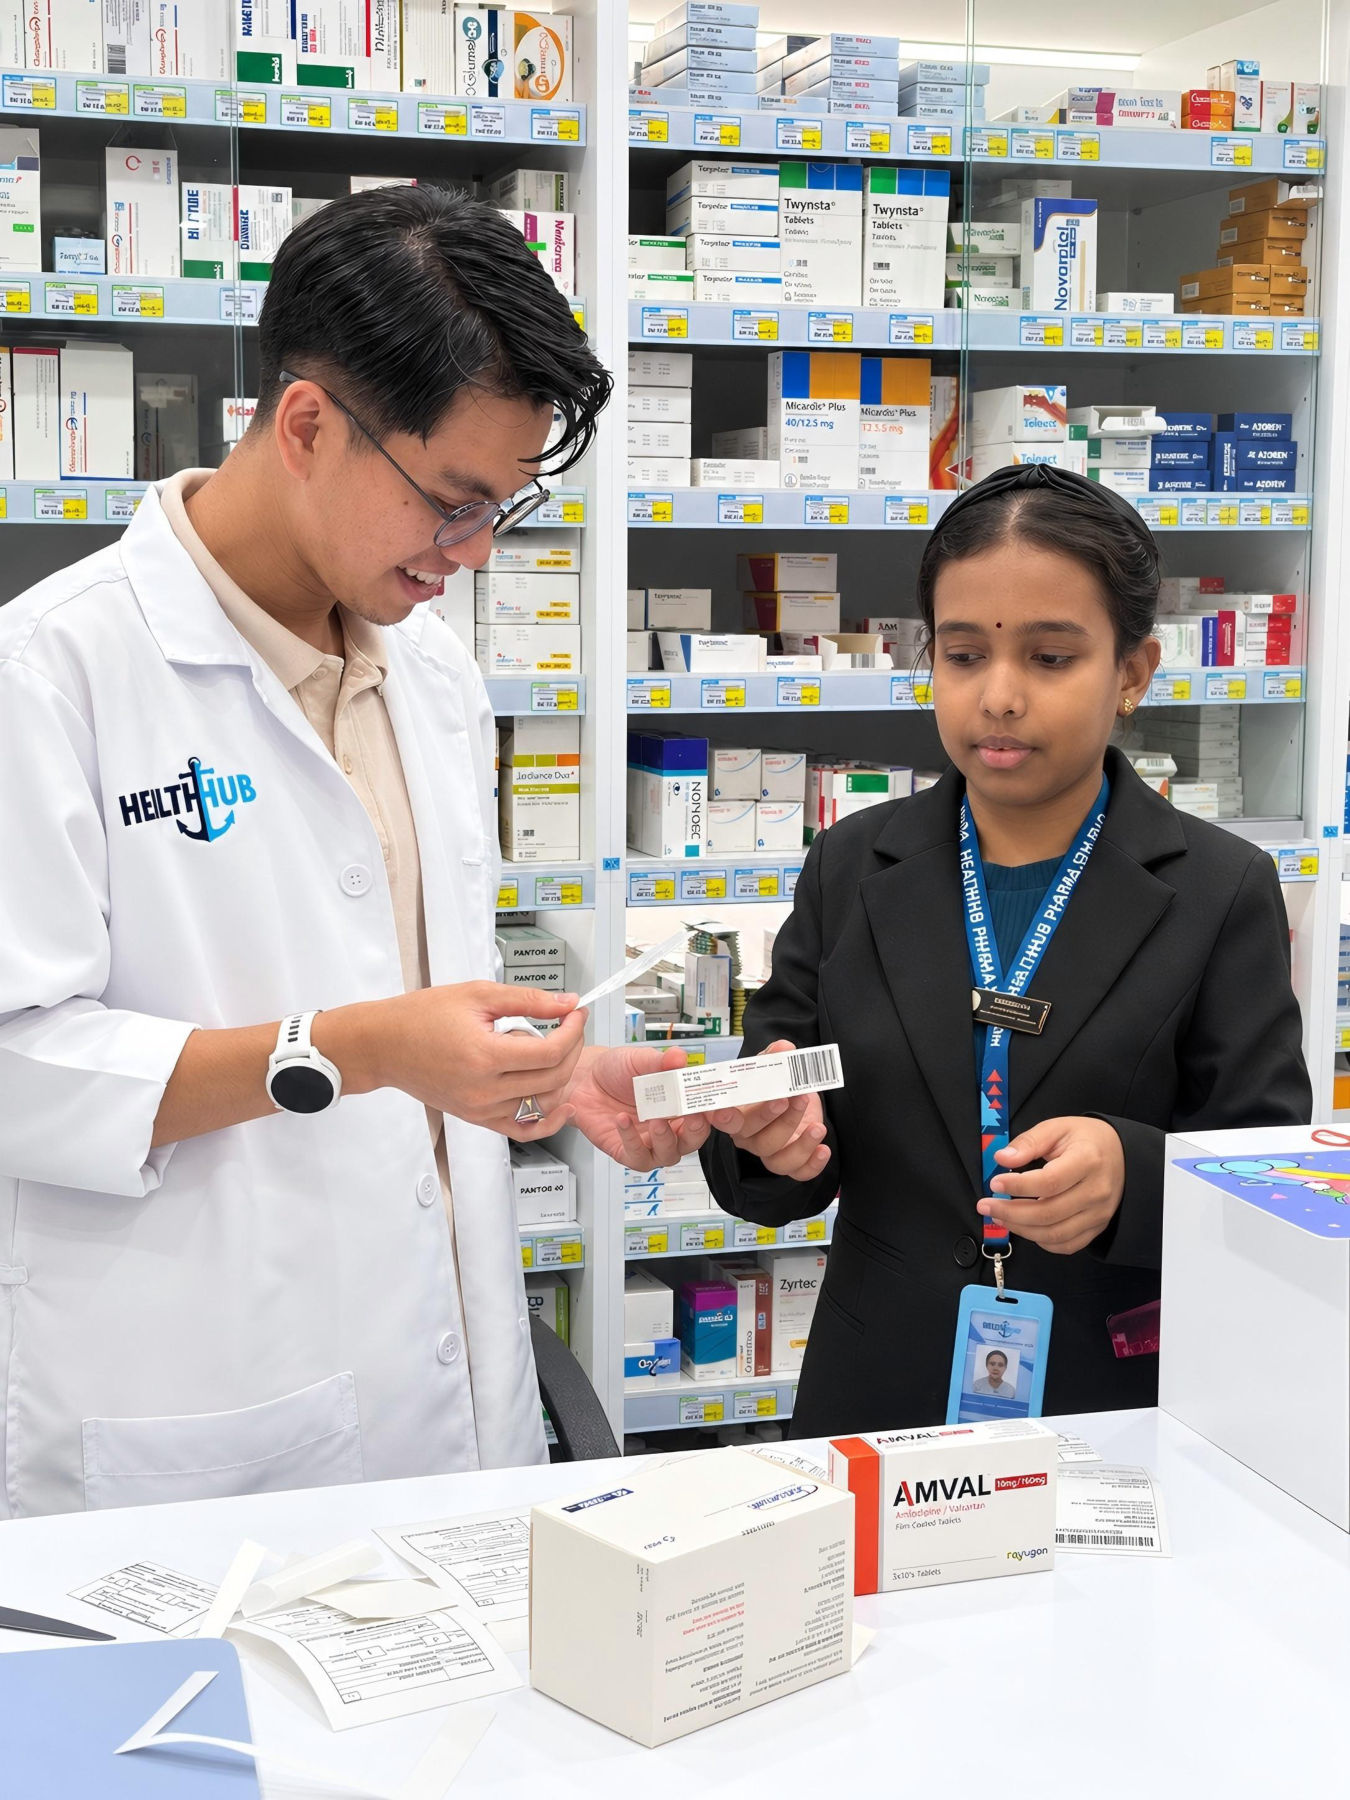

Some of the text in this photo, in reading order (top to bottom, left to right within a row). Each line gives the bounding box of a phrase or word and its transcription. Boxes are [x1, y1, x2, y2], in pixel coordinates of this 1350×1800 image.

[820, 420, 834, 430] mg
[200, 774, 257, 808] HUB
[780, 1279, 817, 1292] Zyrtec
[893, 1474, 991, 1507] AMVAL
